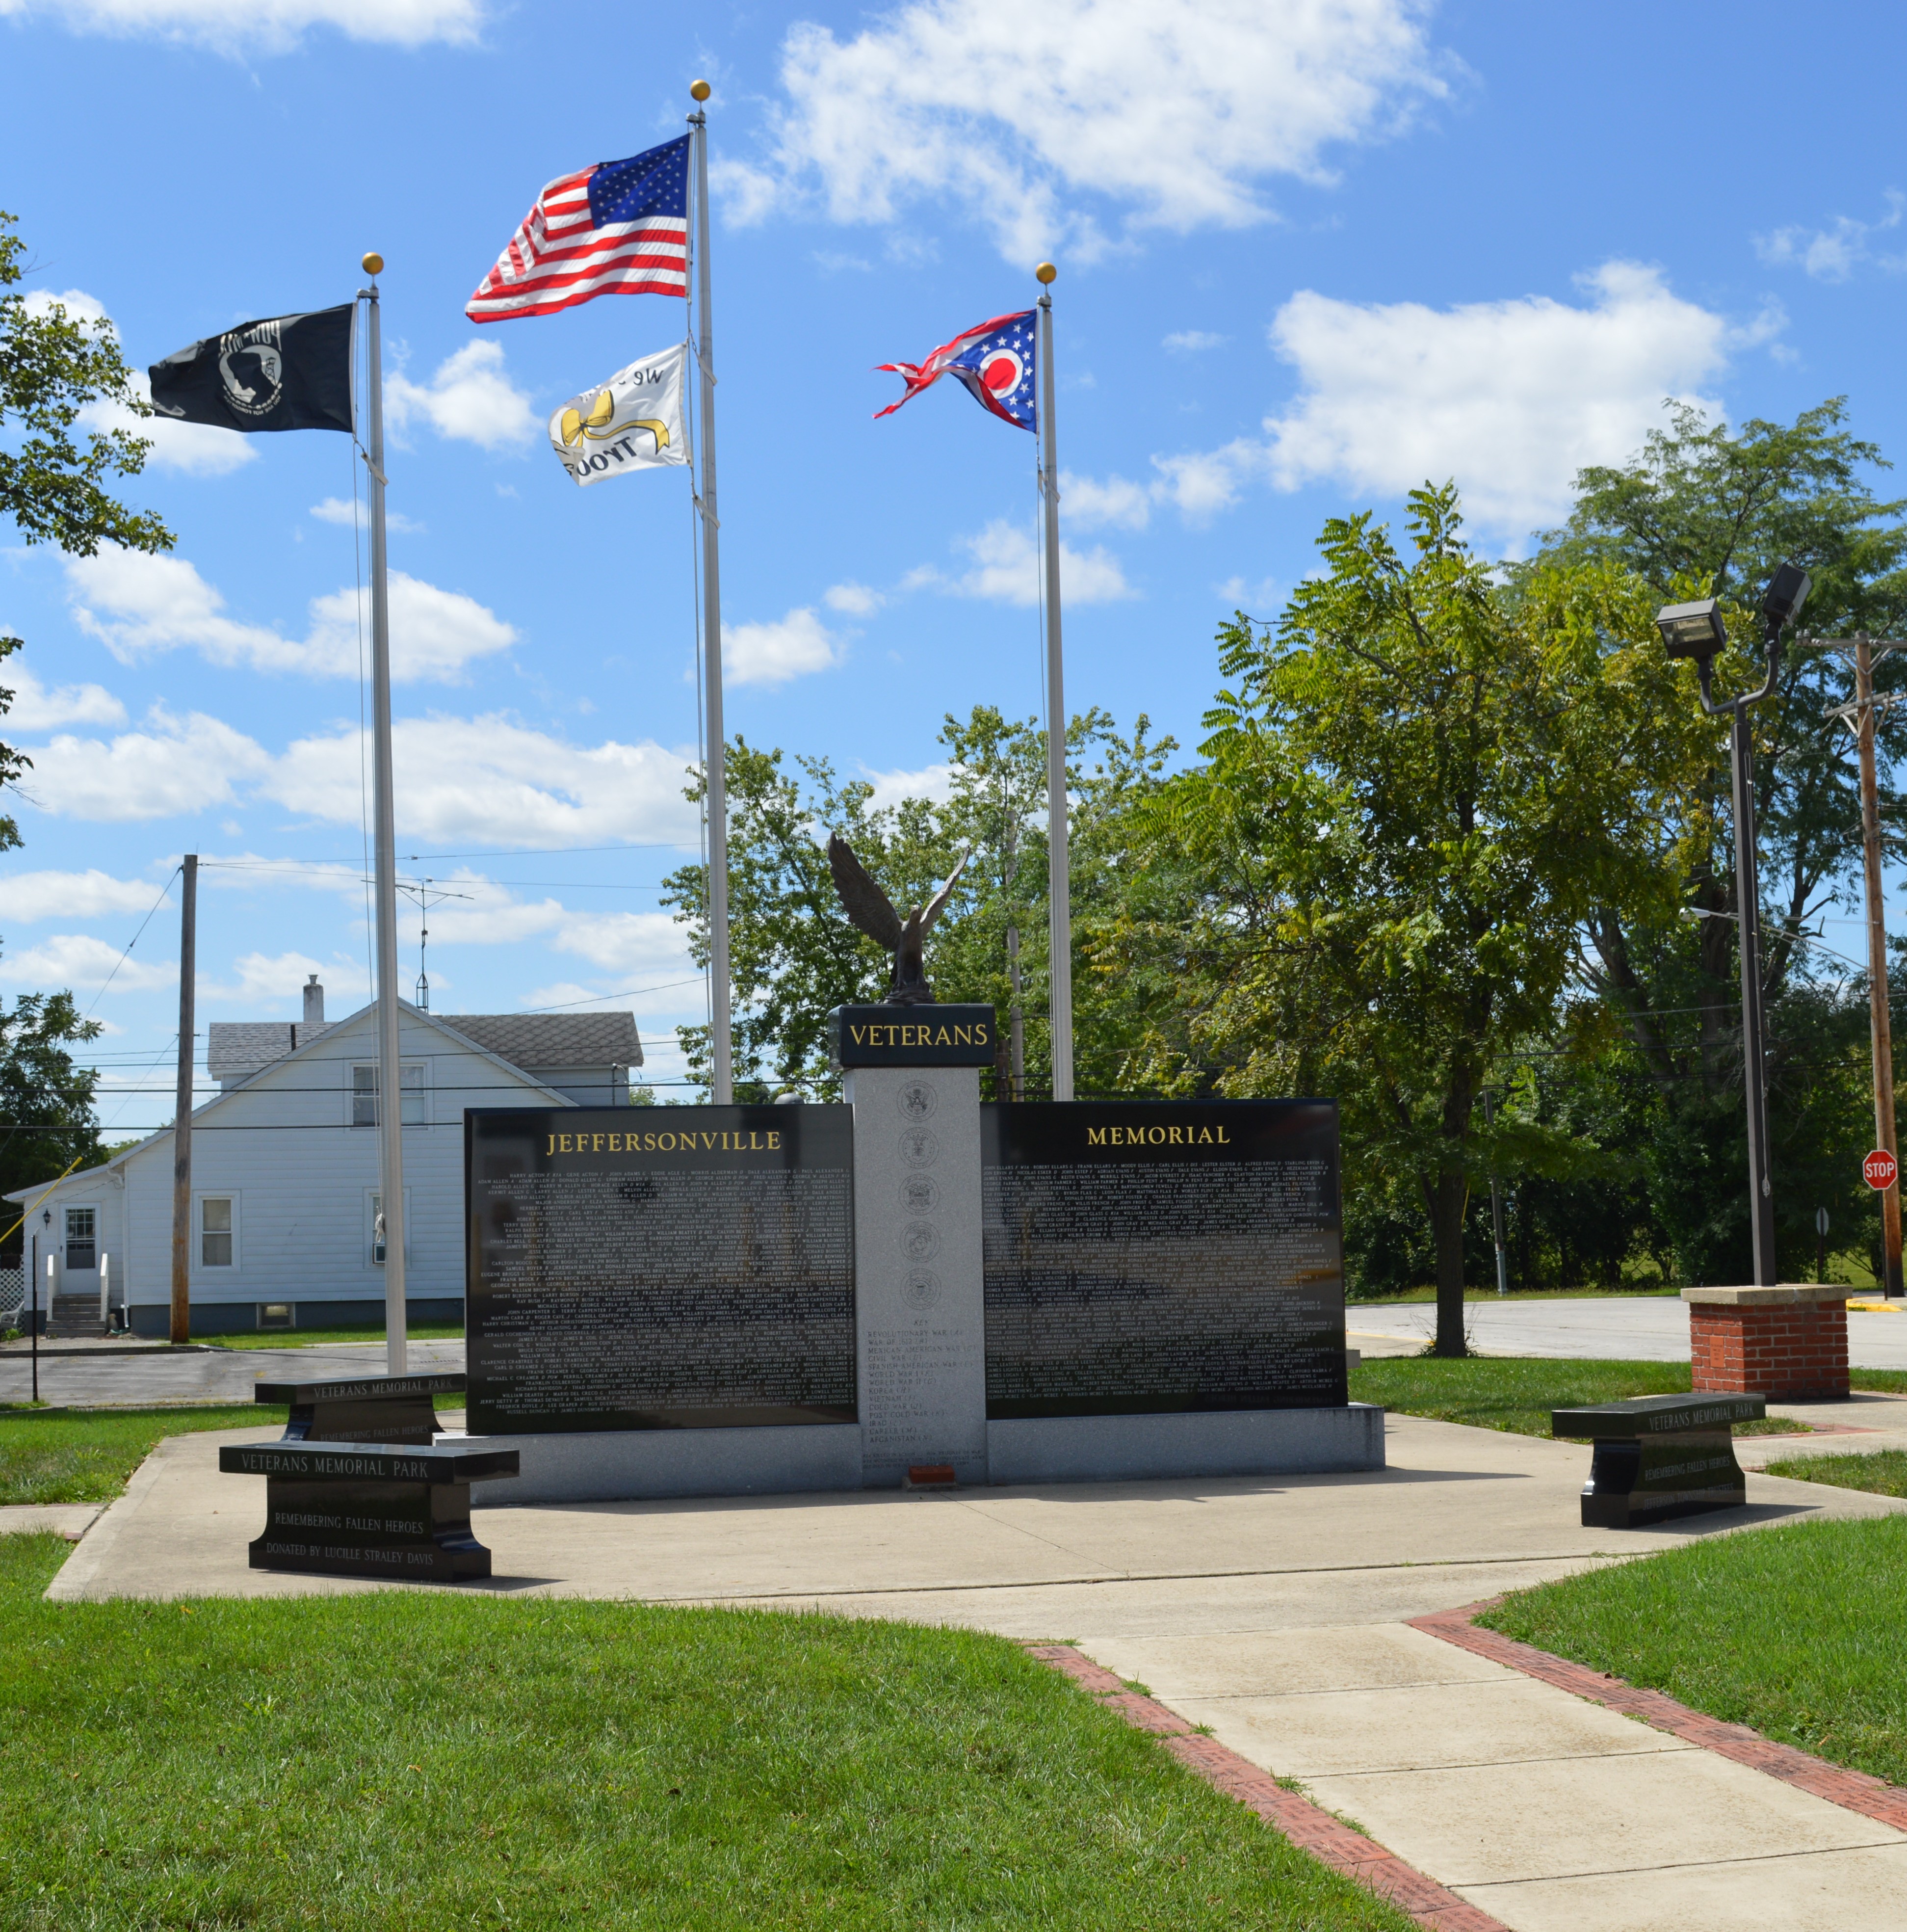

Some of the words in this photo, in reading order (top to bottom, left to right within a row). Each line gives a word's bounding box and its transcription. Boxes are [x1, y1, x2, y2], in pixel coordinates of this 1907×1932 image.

[849, 1024, 987, 1046] VETERANS
[547, 1131, 781, 1155] JEFFERSONVILLE
[1087, 1126, 1230, 1145] MEMORIAL
[1866, 1162, 1895, 1178] STOP
[314, 1384, 367, 1398] VETERANS
[372, 1381, 422, 1395] MEMORIAL
[429, 1378, 453, 1390] PARK
[1649, 1412, 1690, 1431] VETERANS
[1693, 1405, 1732, 1425] MEMORIAL
[1736, 1403, 1754, 1418] PARK
[320, 1430, 370, 1442] REMEMBERING
[374, 1428, 399, 1437] FALLEN
[402, 1425, 428, 1435] HEROES
[241, 1454, 308, 1472] VETERANS
[315, 1457, 385, 1476] MEMORIAL
[393, 1461, 428, 1478] PARK
[1645, 1463, 1685, 1481] REMEMBERING
[1687, 1460, 1707, 1473] FALLEN
[1709, 1456, 1730, 1469] HEROES
[1643, 1495, 1674, 1510] JEFFERSON
[1677, 1488, 1706, 1503] TOWNSHIP
[1708, 1483, 1733, 1498] TRUSTEES
[275, 1513, 341, 1528] REMEMBERING
[346, 1517, 381, 1531] FALLEN
[386, 1519, 423, 1534] HEROES
[266, 1543, 306, 1556] DONATED
[310, 1546, 320, 1557] BY
[325, 1547, 360, 1560] LUCILLE
[365, 1549, 403, 1563] STRALEY
[408, 1552, 433, 1565] DAVIS
